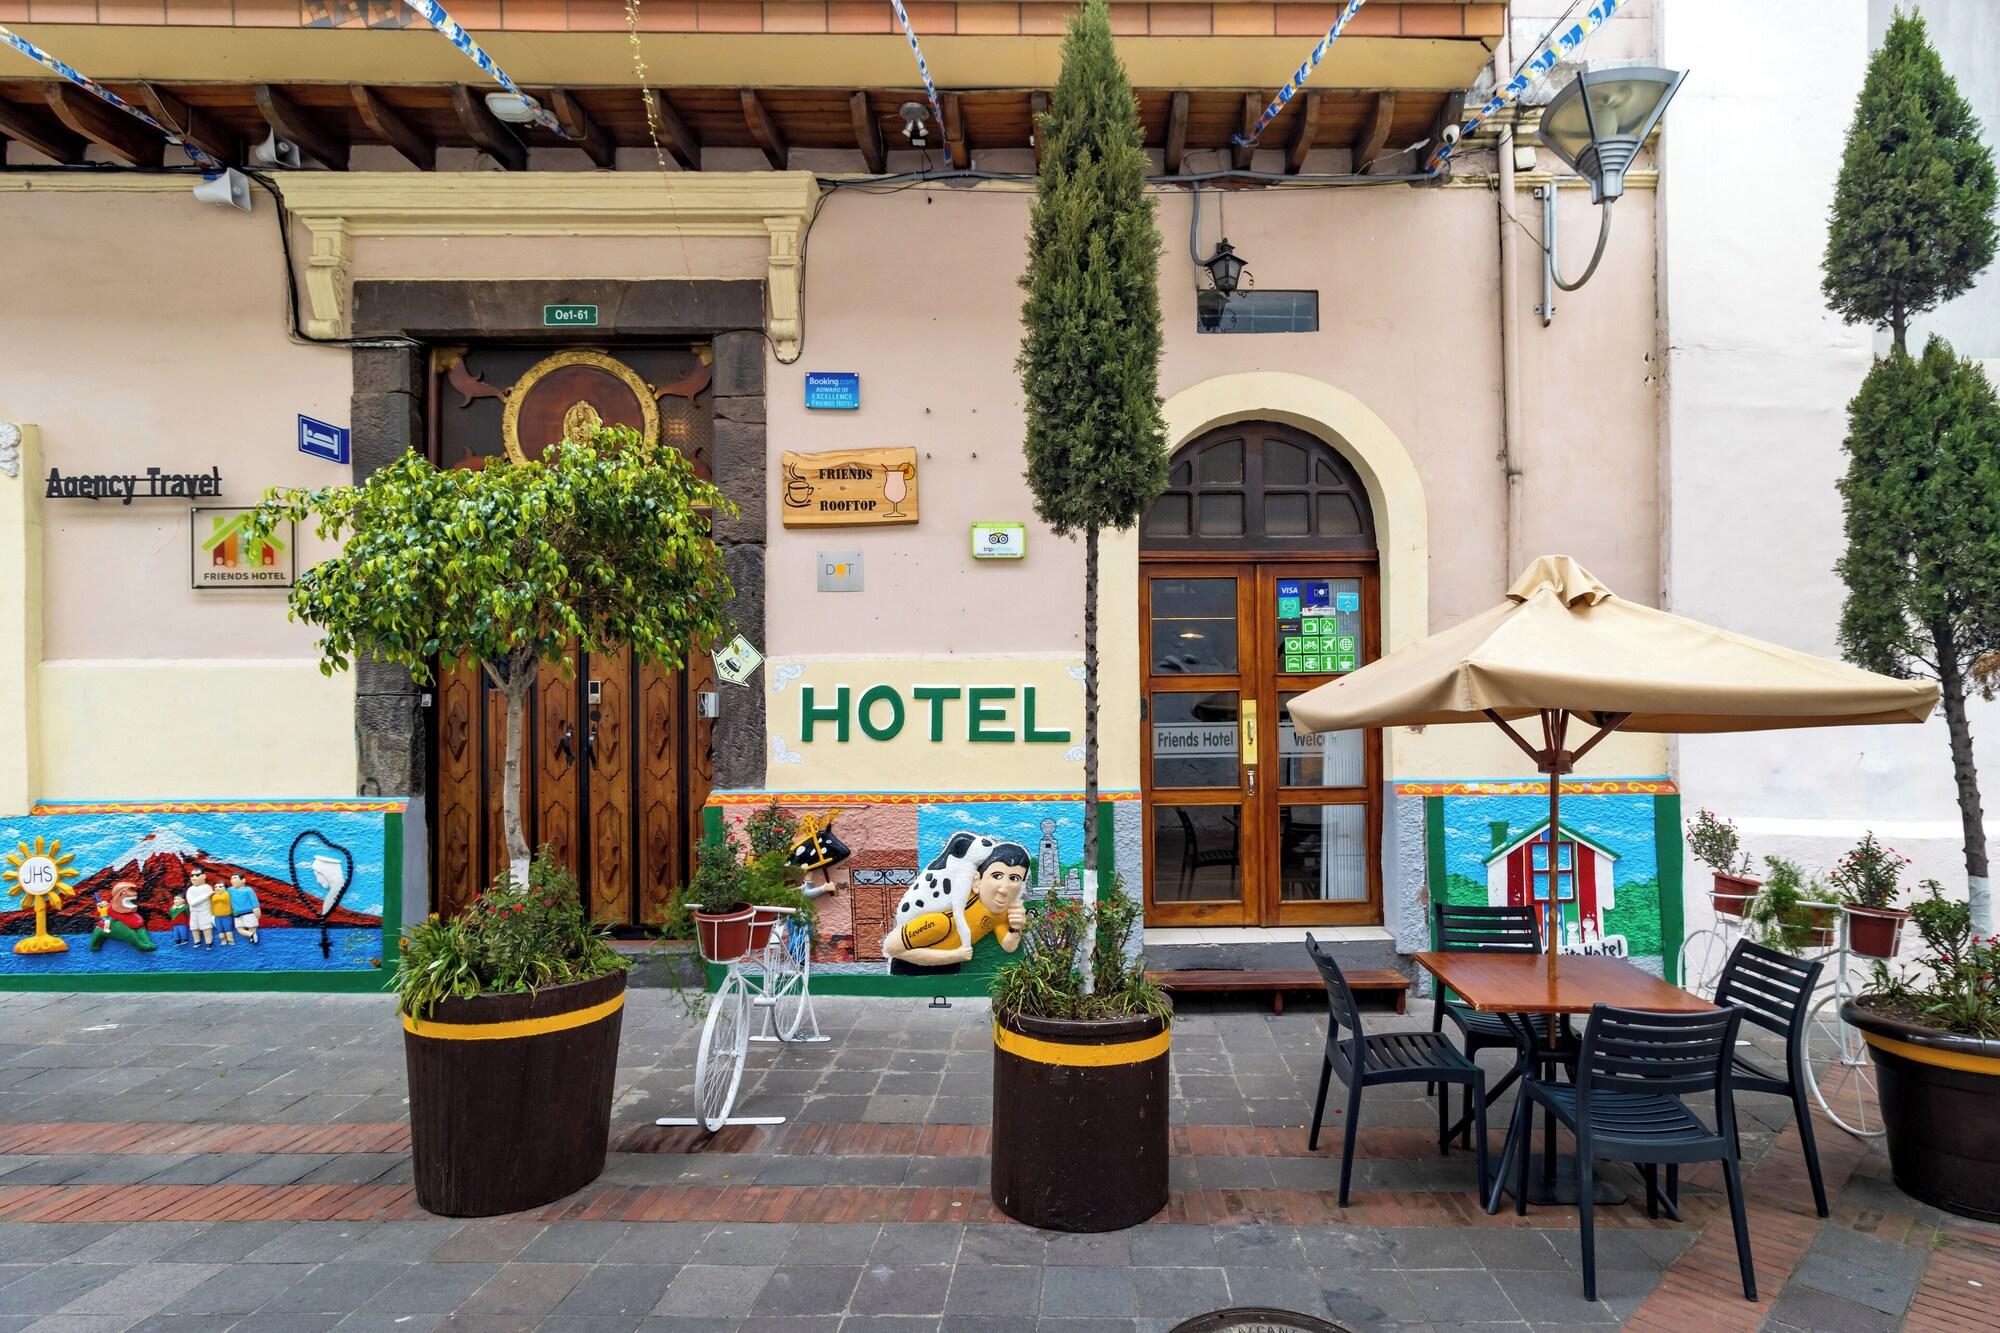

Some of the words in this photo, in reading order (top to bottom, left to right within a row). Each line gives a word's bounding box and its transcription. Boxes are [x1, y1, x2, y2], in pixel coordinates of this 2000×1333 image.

[555, 310, 588, 320] Oe1-61
[818, 468, 873, 480] FRIENDS
[46, 467, 137, 505] Agency
[147, 466, 220, 497] Travel
[820, 500, 877, 512] ROOFTOP
[203, 572, 249, 581] FRIENDS
[251, 572, 287, 580] HOTEL
[718, 662, 736, 680] BELL
[801, 684, 1071, 742] HOTEL
[1157, 732, 1199, 748] Friends
[1202, 731, 1234, 747] Hotel
[23, 865, 53, 884] JHS
[909, 920, 935, 938] Ecuador
